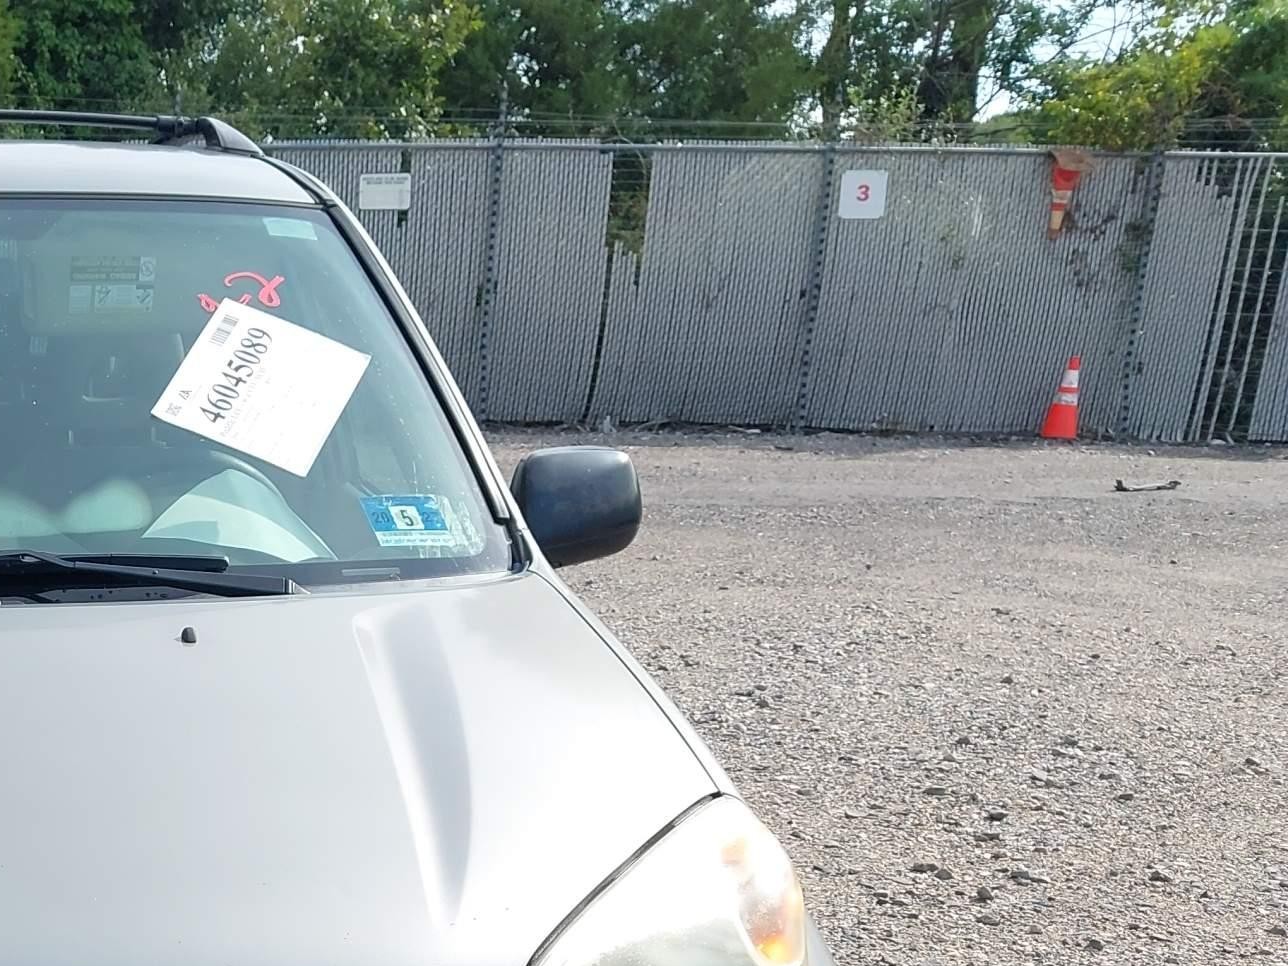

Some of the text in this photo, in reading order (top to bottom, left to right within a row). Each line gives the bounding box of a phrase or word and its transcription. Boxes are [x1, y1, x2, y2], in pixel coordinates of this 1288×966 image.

[856, 184, 870, 202] 3
[199, 326, 273, 424] 46045089
[399, 509, 415, 528] 5
